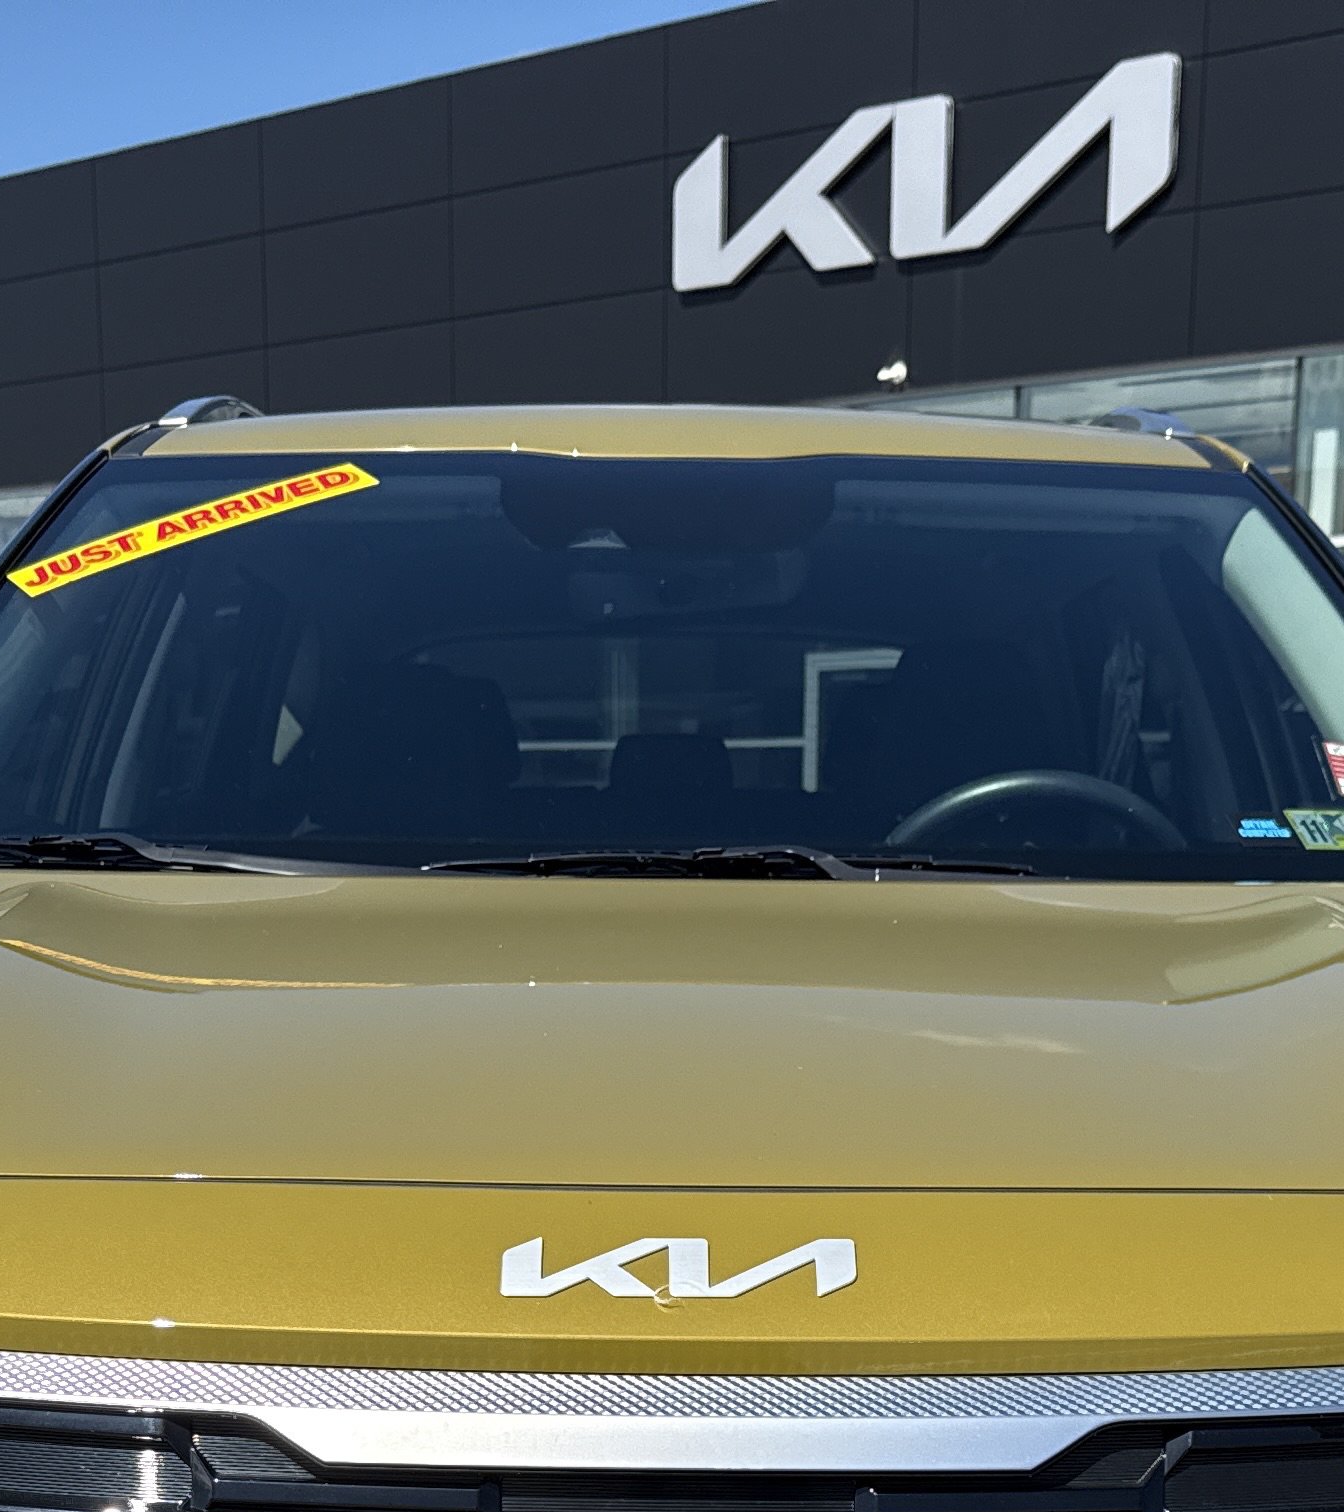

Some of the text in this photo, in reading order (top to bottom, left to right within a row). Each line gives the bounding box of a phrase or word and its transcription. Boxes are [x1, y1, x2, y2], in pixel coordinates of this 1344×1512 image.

[673, 52, 1182, 292] KIA
[24, 471, 356, 588] JUST ARRIVED
[500, 1237, 857, 1298] KIA
